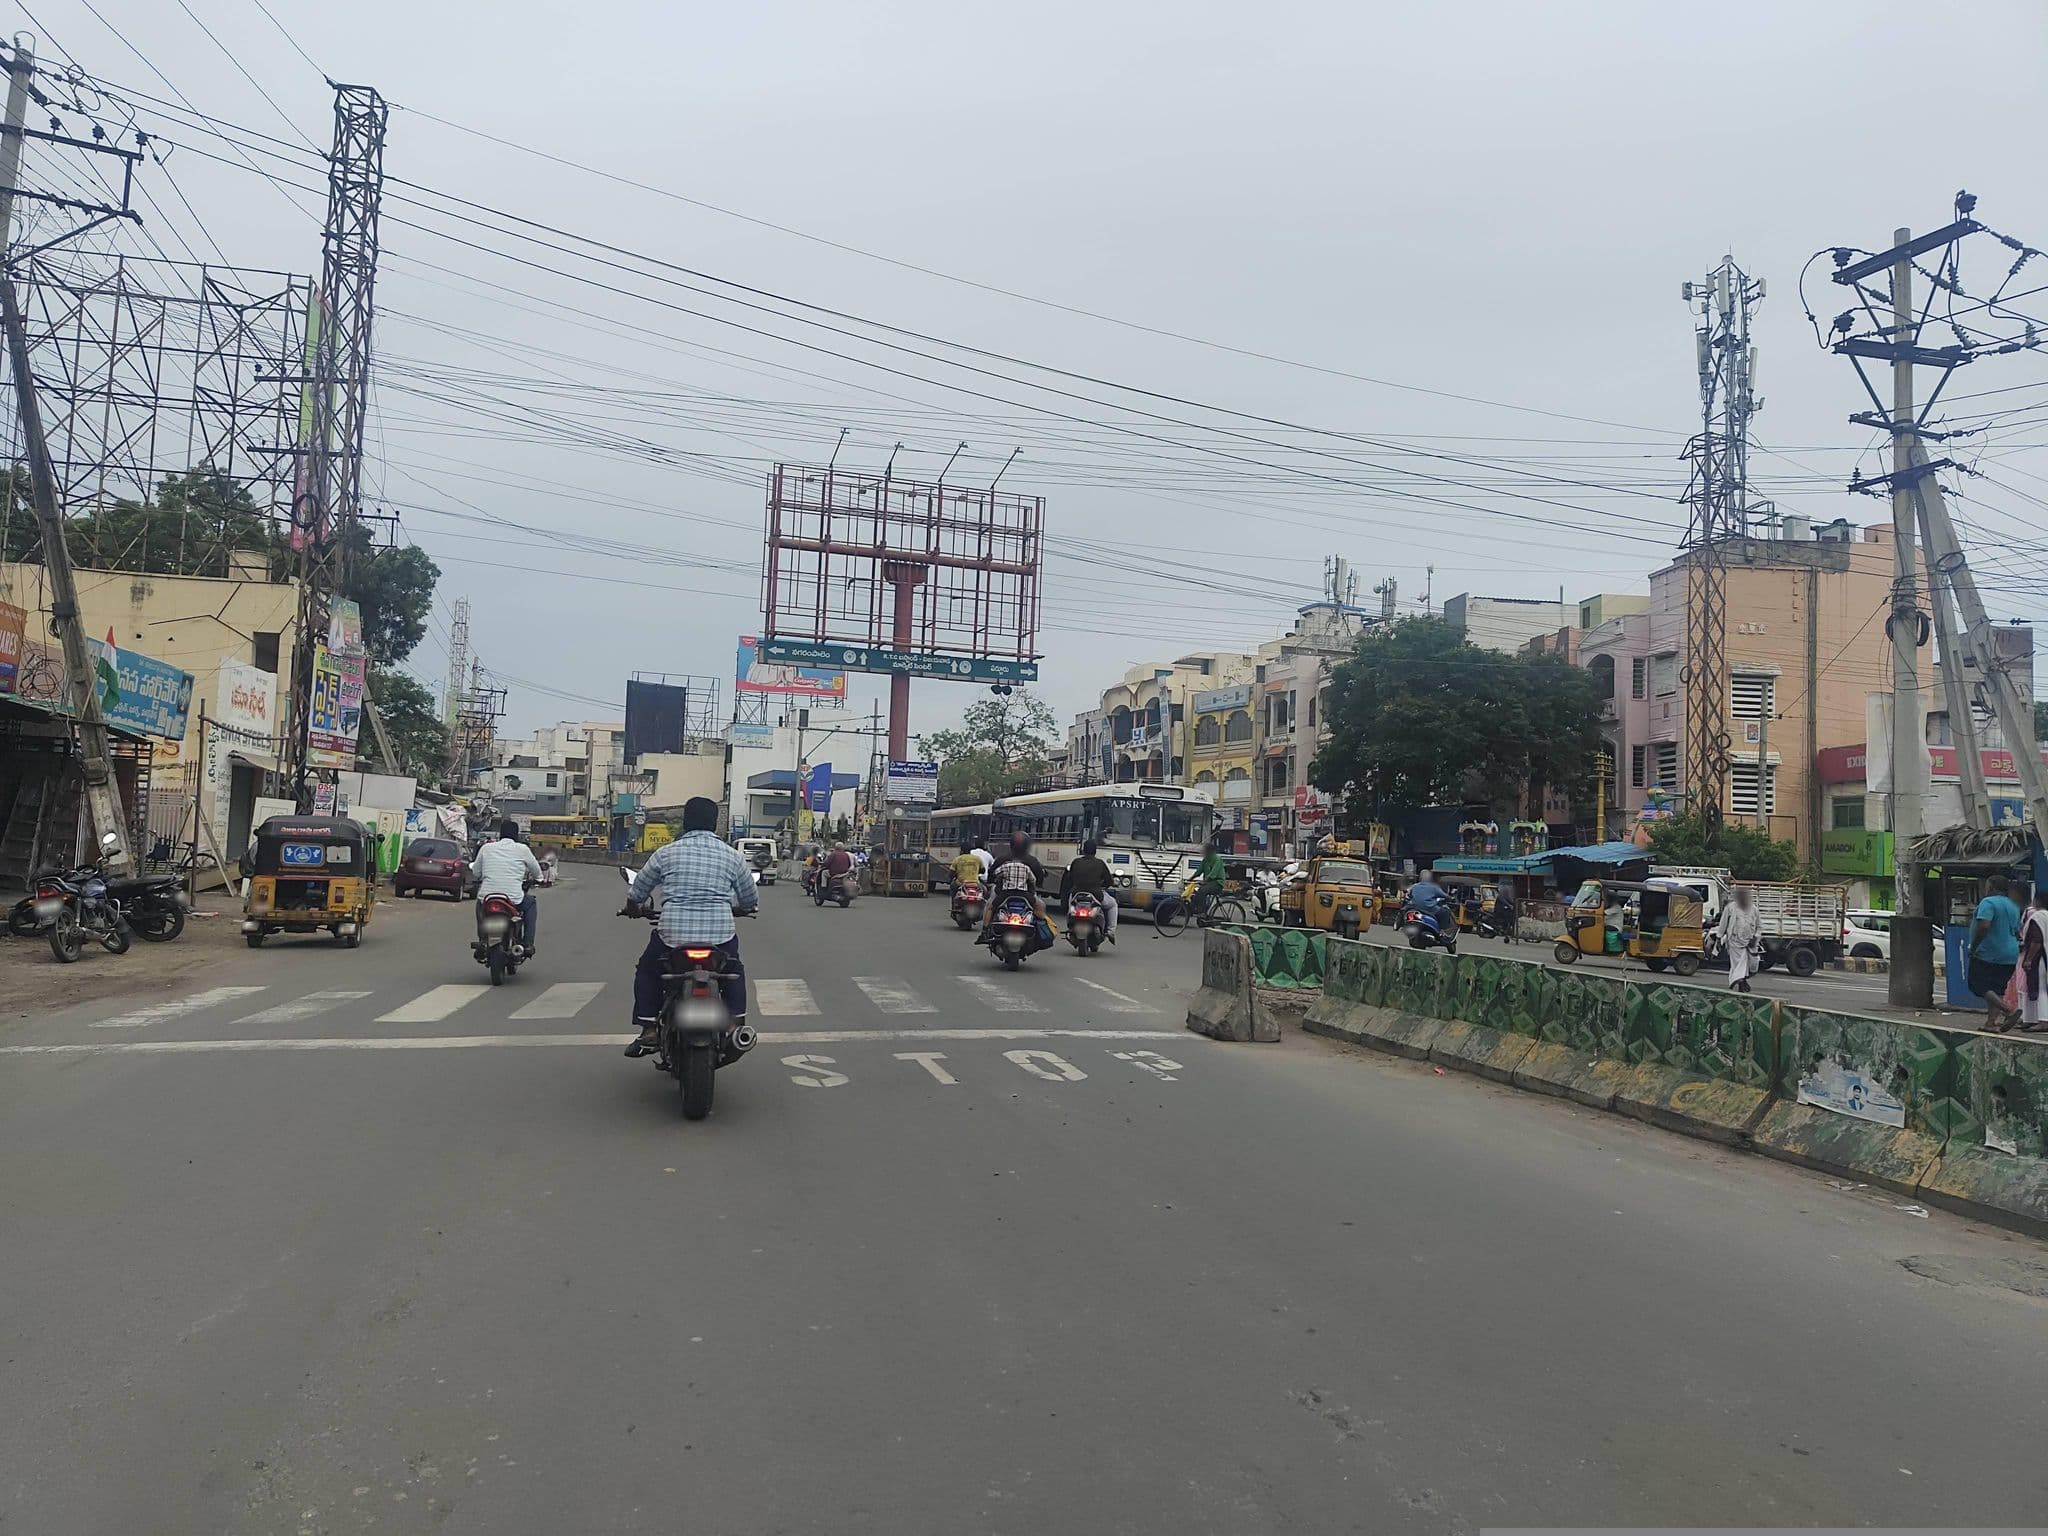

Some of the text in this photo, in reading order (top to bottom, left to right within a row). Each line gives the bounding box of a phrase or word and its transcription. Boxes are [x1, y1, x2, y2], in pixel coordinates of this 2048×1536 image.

[791, 648, 831, 658] నగరంపాలెం
[1824, 842, 1856, 853] AMARON
[780, 1048, 1184, 1088] STOP
